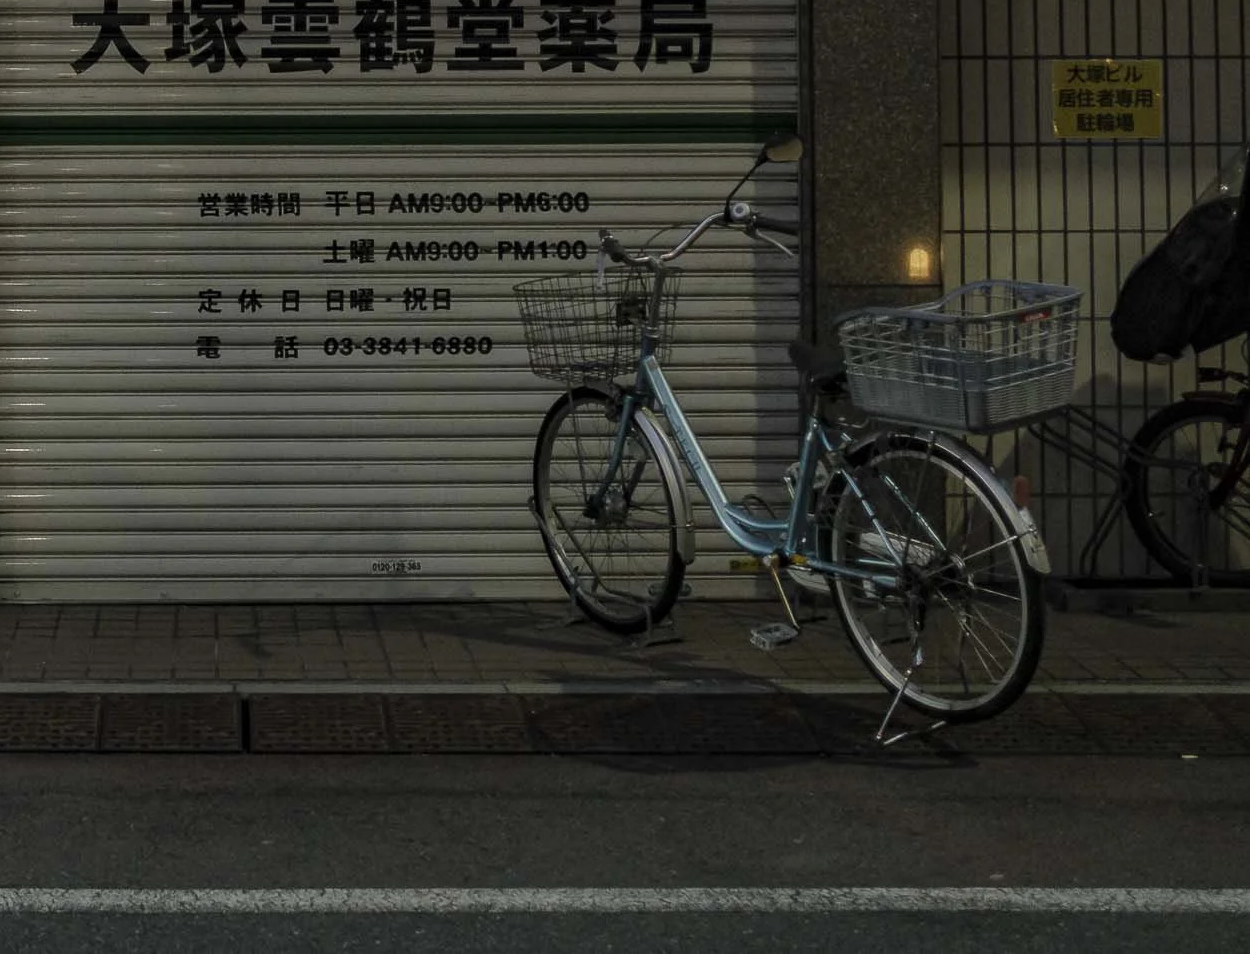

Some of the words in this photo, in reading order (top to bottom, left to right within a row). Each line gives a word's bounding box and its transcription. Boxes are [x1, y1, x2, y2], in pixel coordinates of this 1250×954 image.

[1067, 64, 1143, 83] 大塚ビル
[1058, 88, 1153, 108] 居住者専用
[1077, 113, 1135, 132] 駐輪場
[197, 193, 301, 217] 営業時間
[324, 191, 377, 216] 平日
[323, 239, 376, 264] 土曜
[197, 289, 301, 313] 定休日
[323, 335, 493, 356] 03-3841-6880
